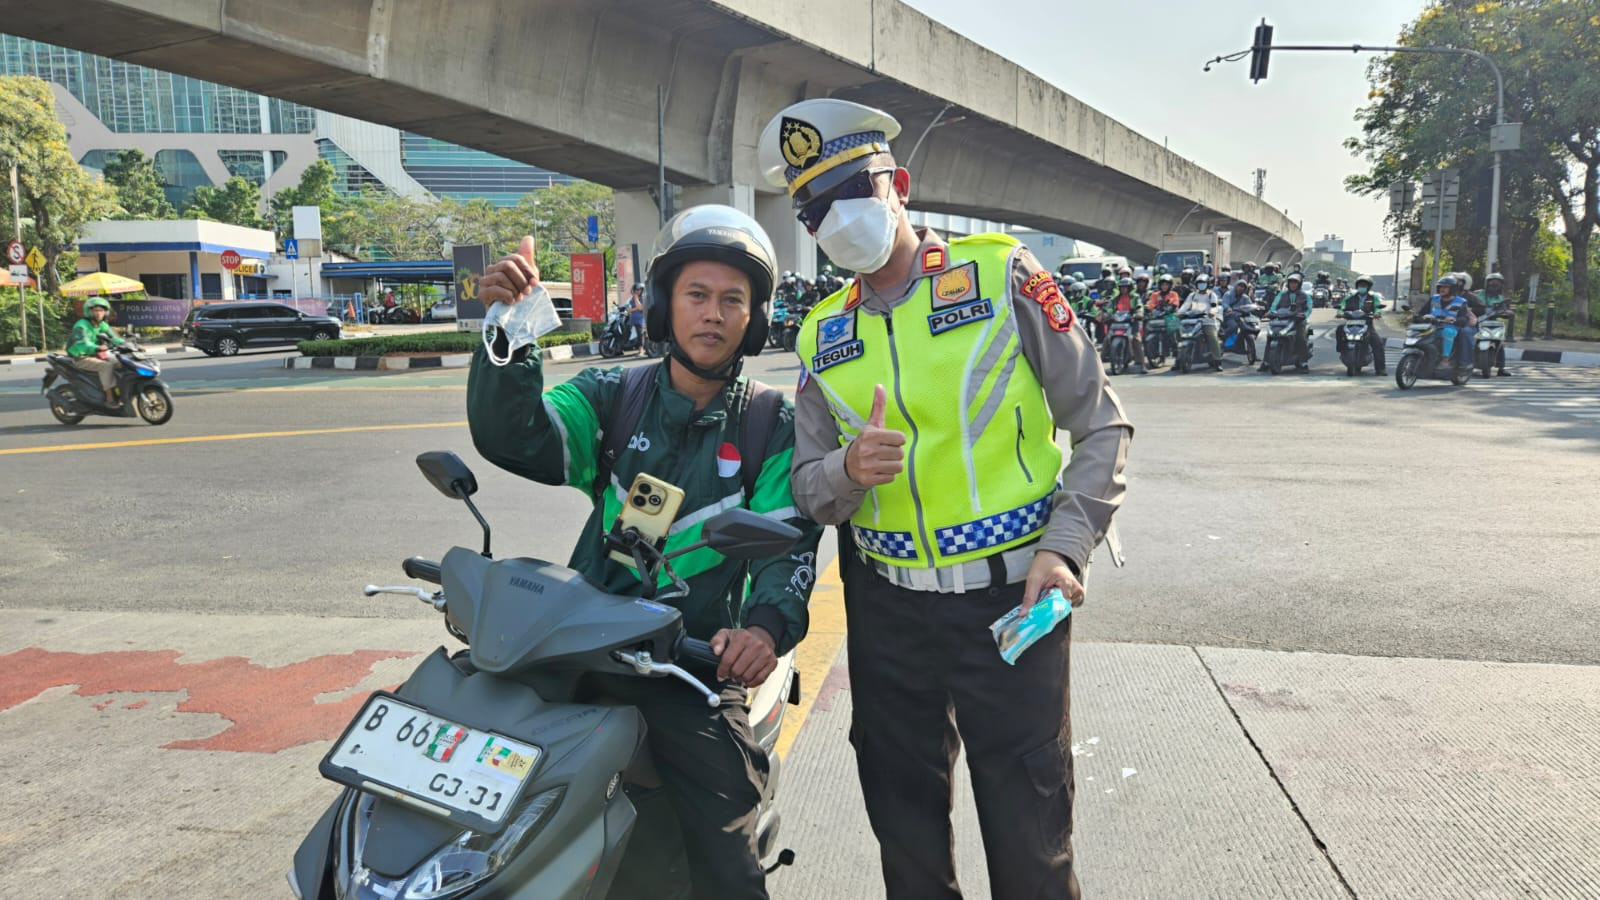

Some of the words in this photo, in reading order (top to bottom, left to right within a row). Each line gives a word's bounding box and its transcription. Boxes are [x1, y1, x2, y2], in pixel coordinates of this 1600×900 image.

[221, 255, 240, 265] STOP
[931, 302, 990, 330] POLRI
[814, 343, 860, 368] TEGUH
[510, 576, 545, 595] YAMAHA
[364, 704, 389, 731] B
